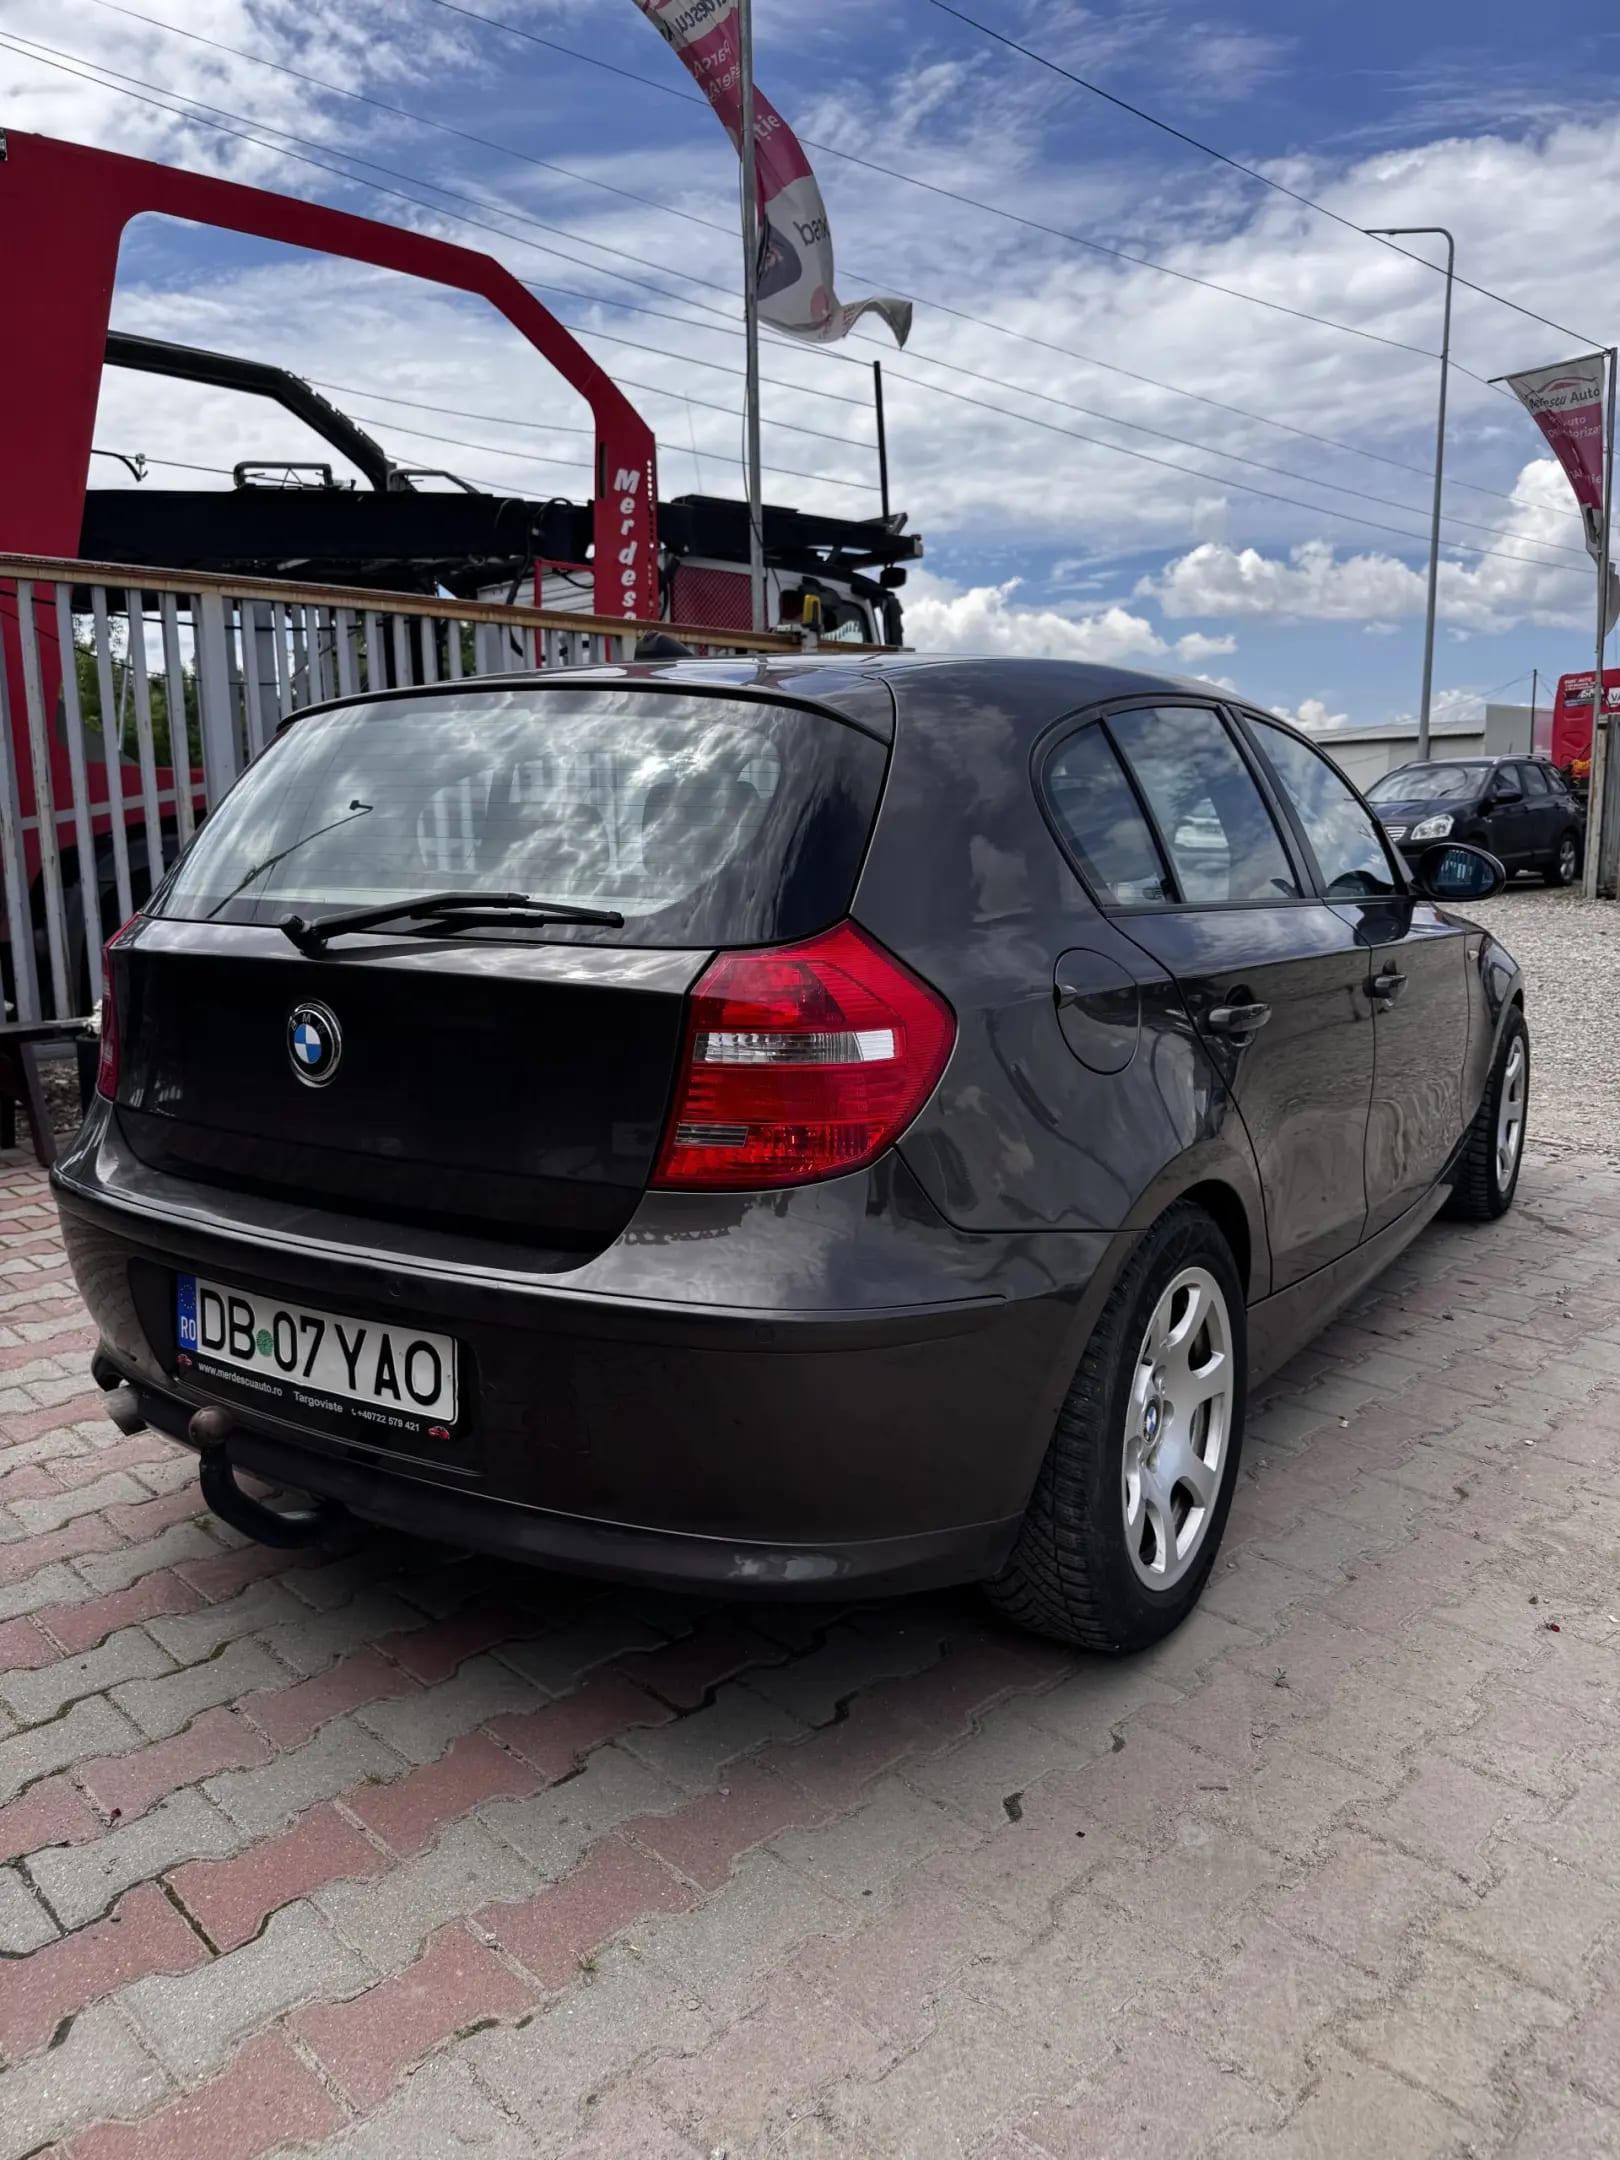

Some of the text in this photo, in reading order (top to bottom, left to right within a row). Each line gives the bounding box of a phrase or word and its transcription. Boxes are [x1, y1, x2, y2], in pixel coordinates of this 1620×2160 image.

[1570, 388, 1600, 405] Auto
[180, 1315, 197, 1342] RO
[199, 1287, 442, 1407] DB 07 YAO
[198, 1362, 283, 1397] www.merdescuauto.ro
[293, 1390, 344, 1413] Targoviste
[404, 1421, 420, 1432] 421
